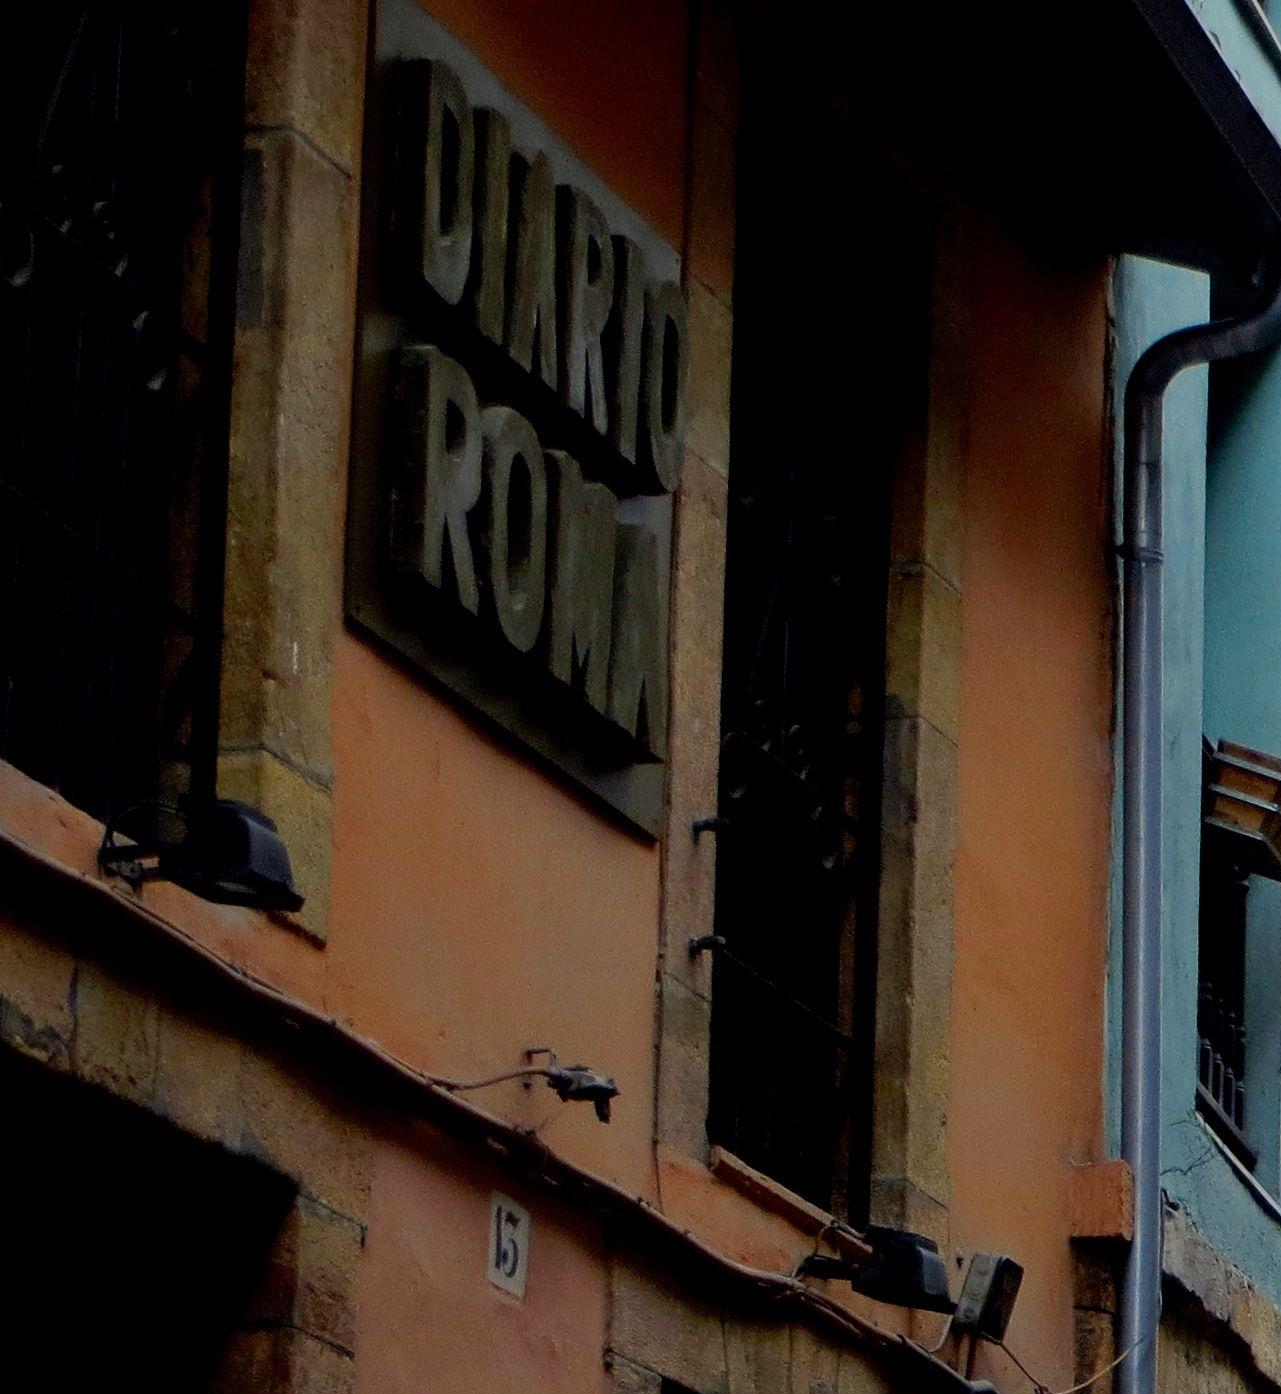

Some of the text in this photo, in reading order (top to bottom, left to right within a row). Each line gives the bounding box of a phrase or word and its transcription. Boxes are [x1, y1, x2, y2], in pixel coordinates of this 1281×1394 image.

[408, 58, 689, 494] DIARIO
[408, 345, 667, 764] ROMA
[495, 1205, 521, 1278] 15
